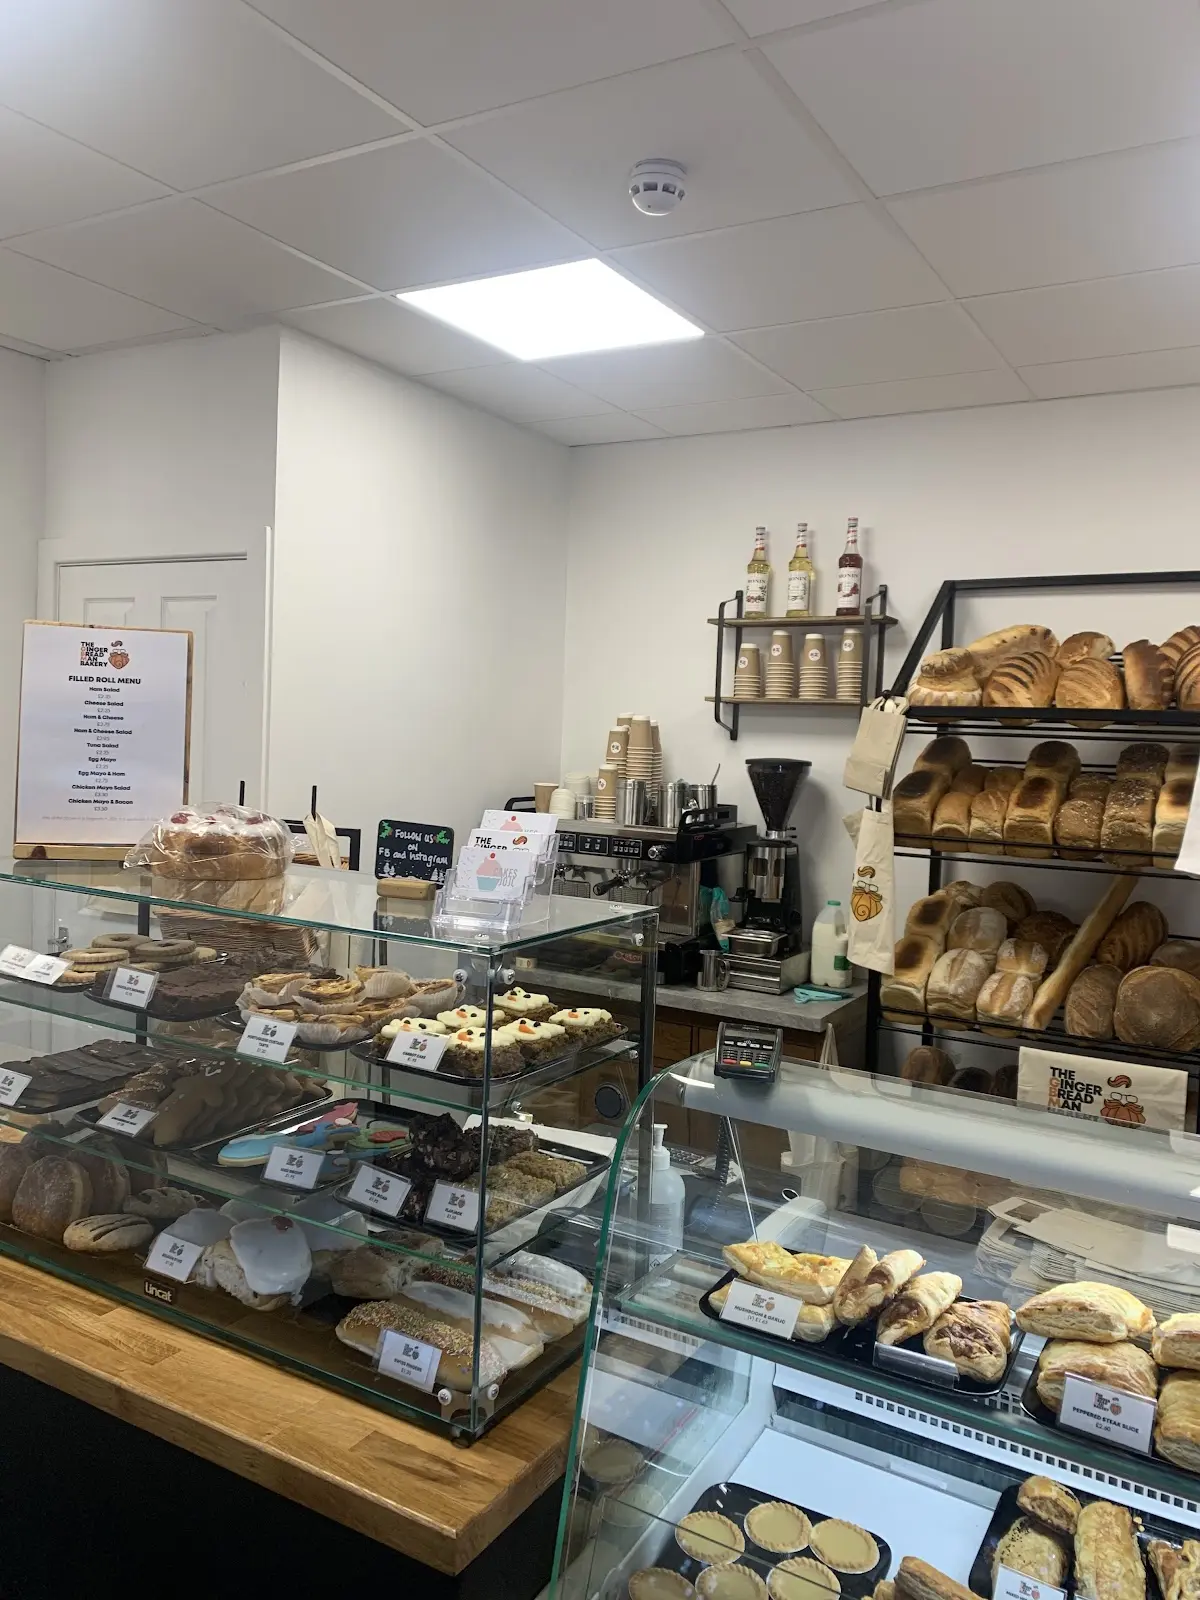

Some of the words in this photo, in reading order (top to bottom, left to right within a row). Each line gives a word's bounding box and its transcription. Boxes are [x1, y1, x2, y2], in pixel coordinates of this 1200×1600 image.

[475, 836, 492, 844] THE
[378, 847, 390, 857] FB
[393, 851, 406, 859] and
[409, 852, 448, 867] Instagram
[1050, 1066, 1076, 1081] THE
[1050, 1078, 1102, 1096] GINGER
[1049, 1087, 1094, 1104] BREAD
[1048, 1097, 1081, 1112] MAN
[365, 1188, 378, 1196] ROCKY
[734, 1305, 764, 1318] MUSHROOM
[767, 1315, 786, 1324] GARLIC
[394, 1358, 406, 1366] SWISS
[1072, 1406, 1102, 1421] PEPPERED
[1102, 1417, 1121, 1428] STEAK
[1122, 1424, 1140, 1434] SLICE
